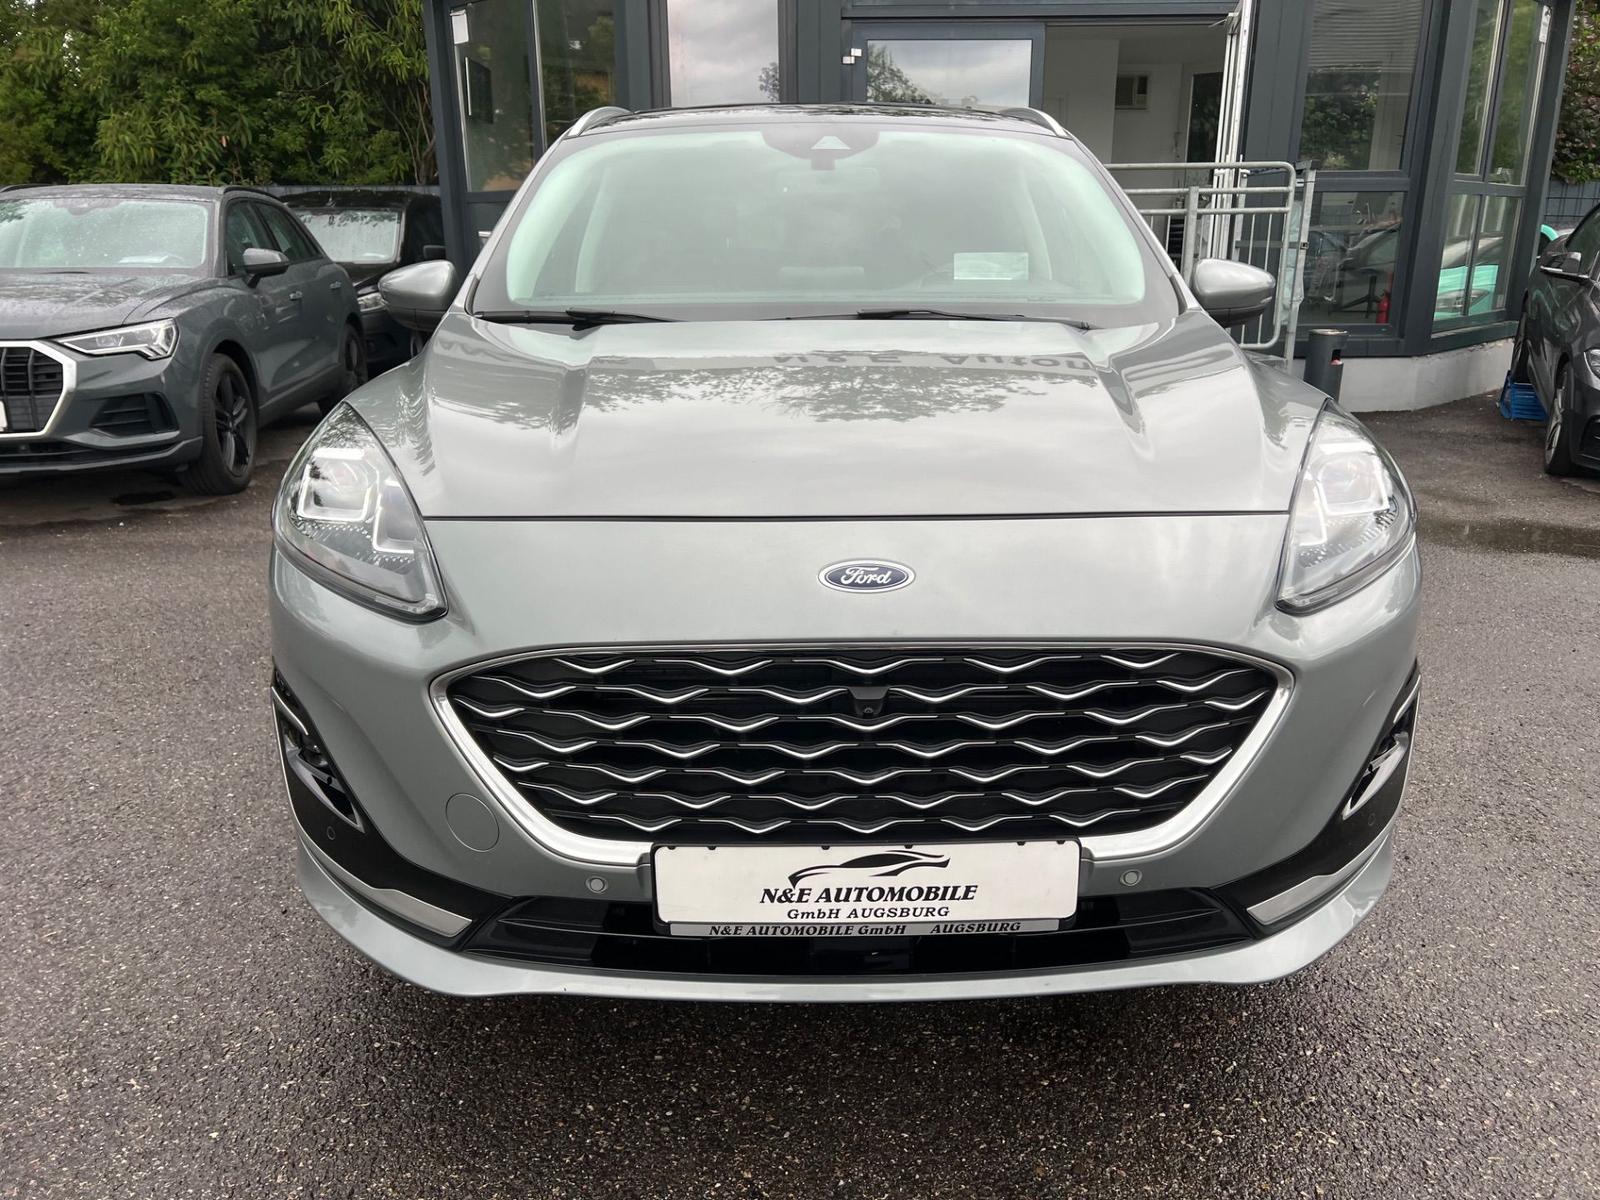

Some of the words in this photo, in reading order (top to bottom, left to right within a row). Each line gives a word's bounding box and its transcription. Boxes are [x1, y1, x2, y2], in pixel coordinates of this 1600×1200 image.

[841, 567, 892, 585] Ford
[760, 888, 812, 903] N&E
[815, 885, 978, 903] AUTOMOBILE
[787, 909, 841, 919] GmbH
[847, 907, 950, 918] AUGSBURG
[709, 926, 743, 935] N&E
[747, 925, 854, 935] AUTOMOBILE
[858, 925, 906, 935] GmbH
[930, 922, 1021, 934] AUGSBURG
